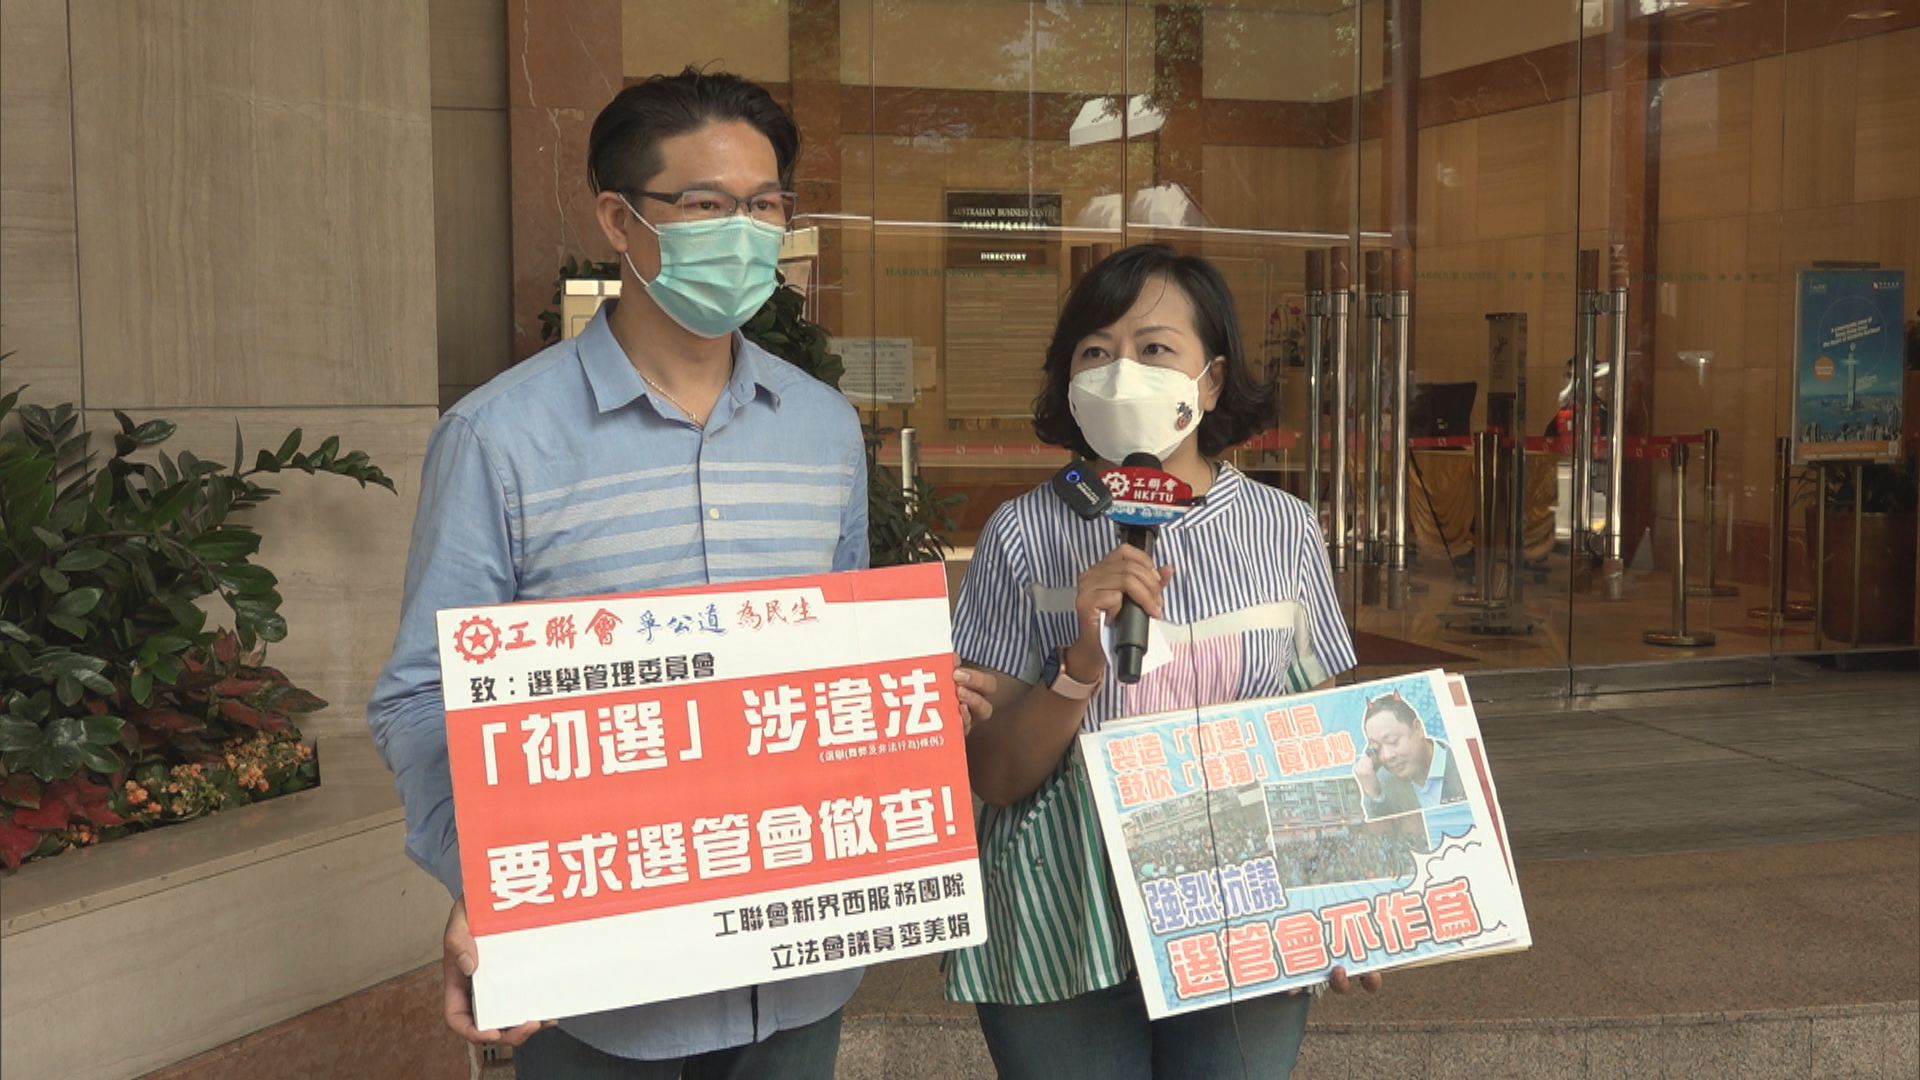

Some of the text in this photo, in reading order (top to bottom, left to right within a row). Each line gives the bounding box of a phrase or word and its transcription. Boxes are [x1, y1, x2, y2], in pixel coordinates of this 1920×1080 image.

[998, 207, 1028, 217] BUSINESS
[980, 252, 1027, 261] DIRECTORY
[1133, 489, 1175, 503] HKFTU
[504, 608, 623, 650] 工聯會
[713, 872, 967, 938] 工聯會新界西服務團隊
[1143, 859, 1286, 933] 強烈抗議
